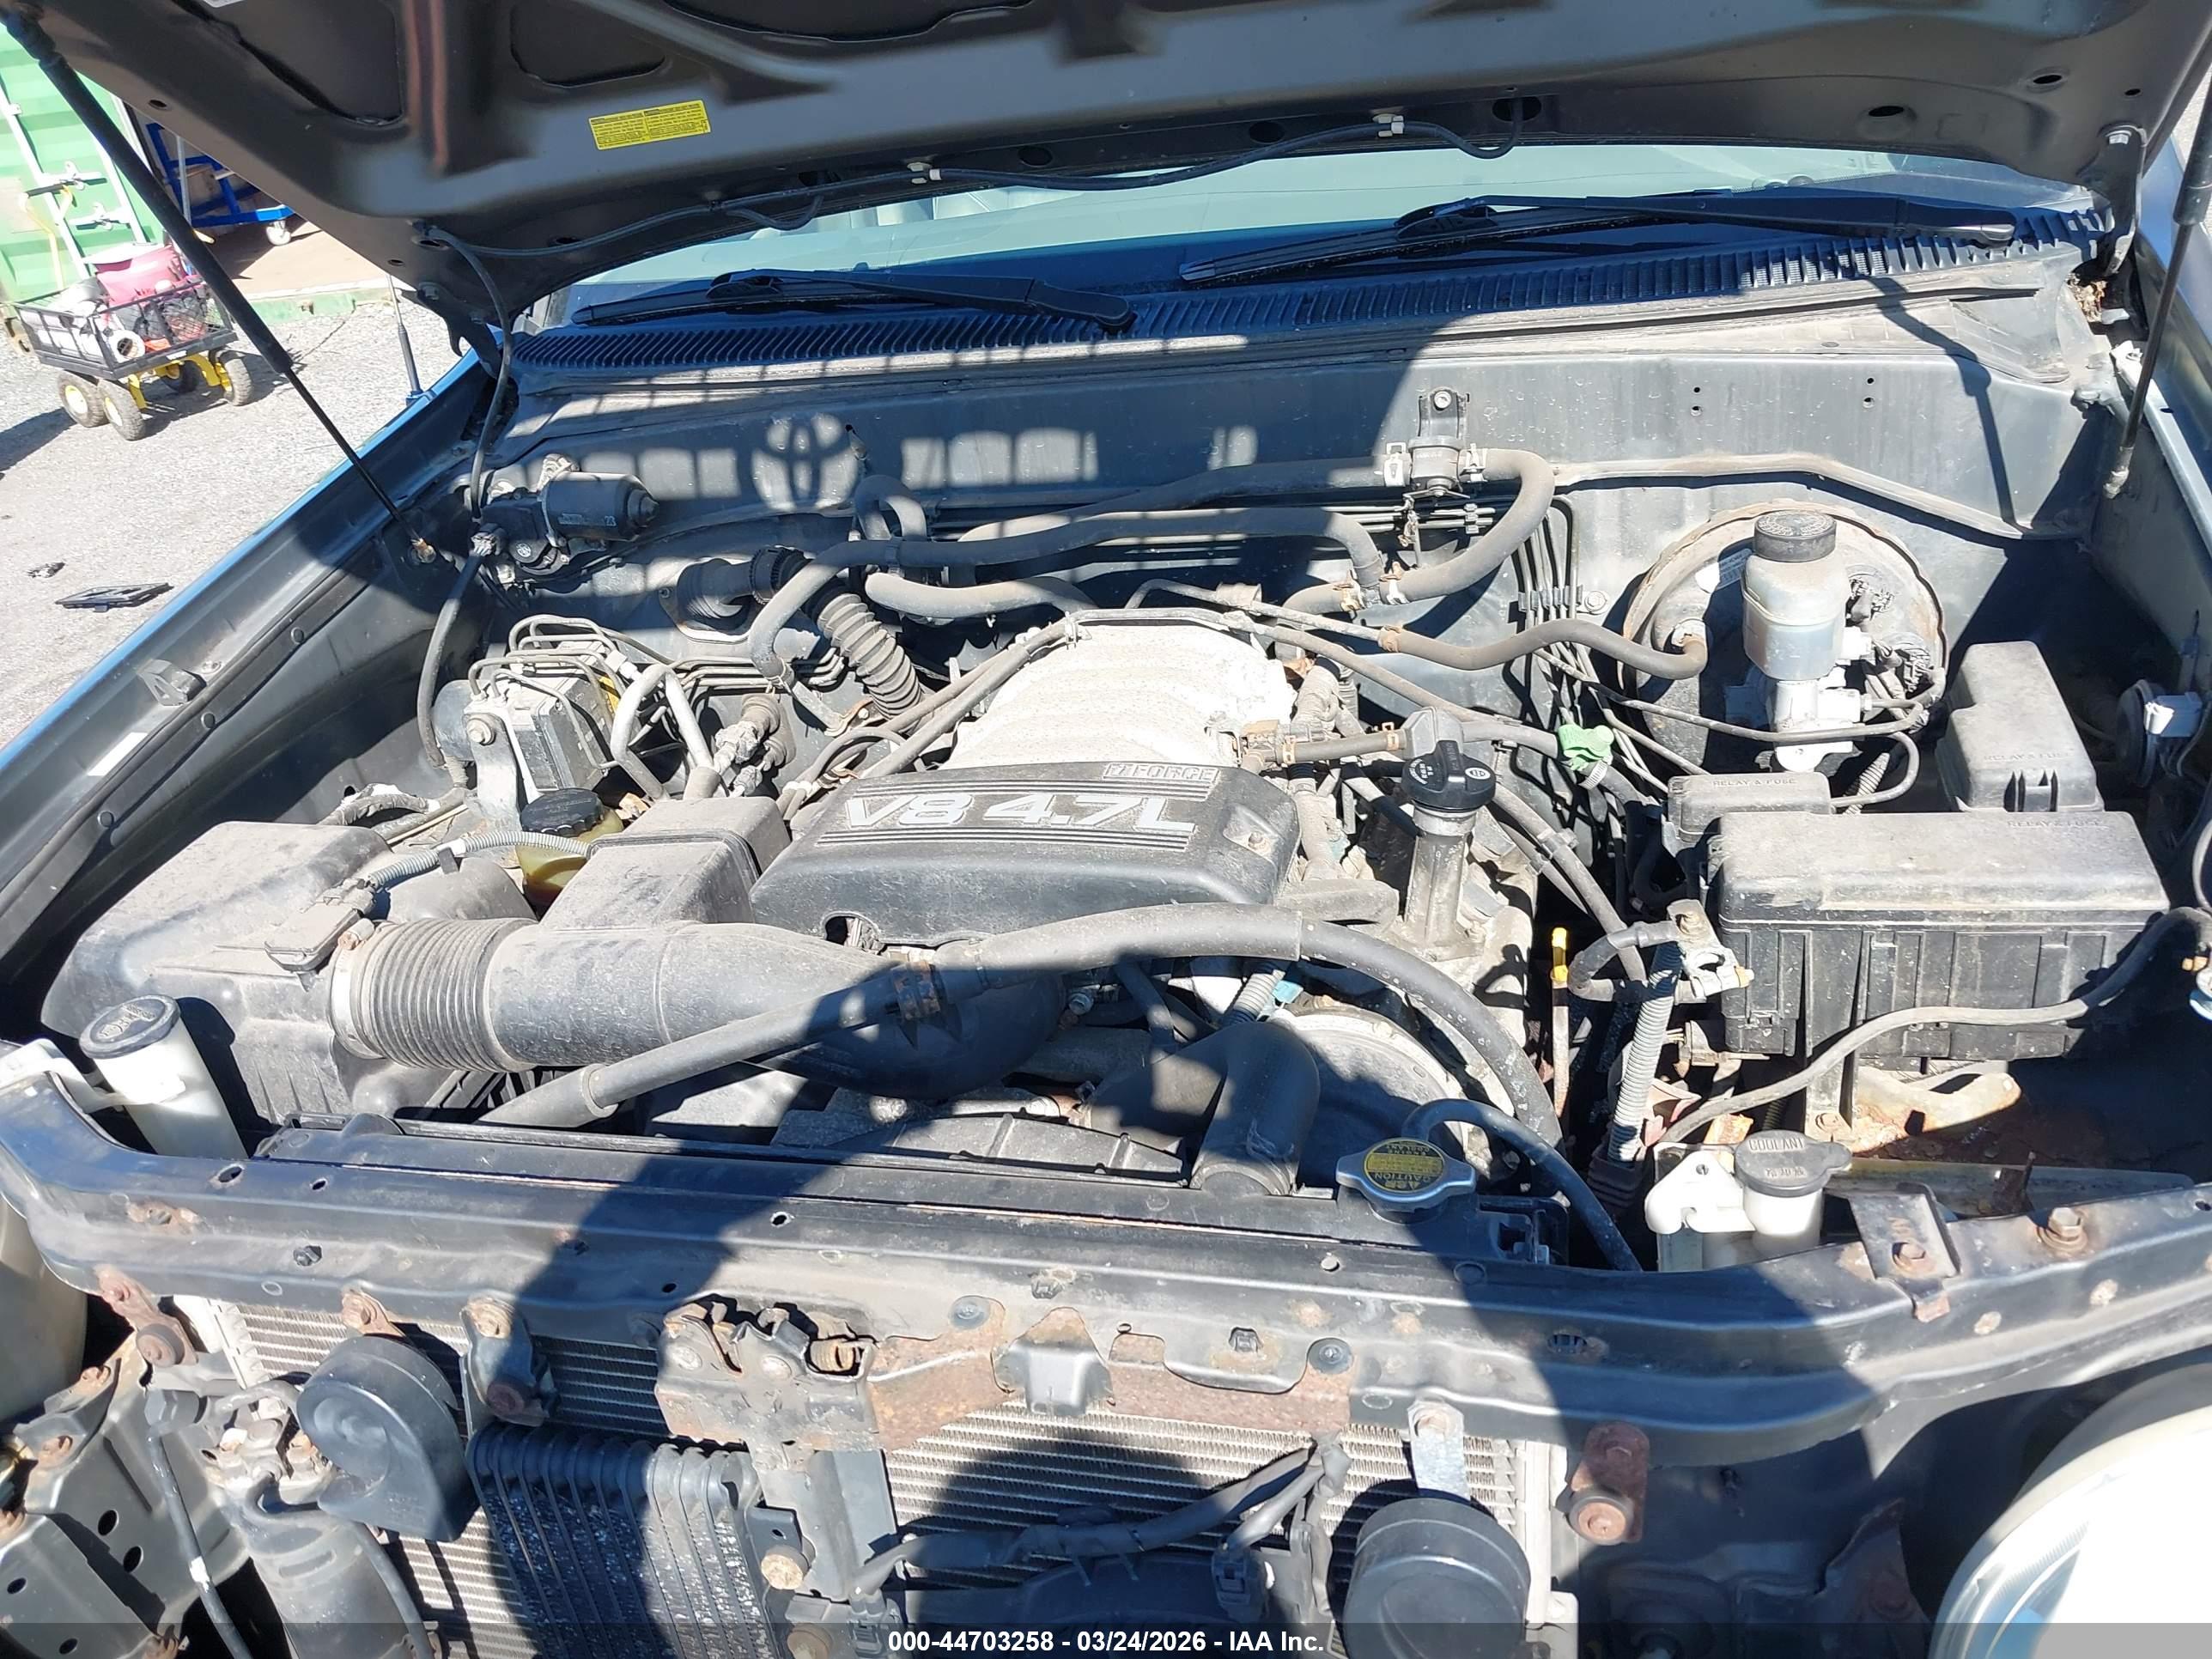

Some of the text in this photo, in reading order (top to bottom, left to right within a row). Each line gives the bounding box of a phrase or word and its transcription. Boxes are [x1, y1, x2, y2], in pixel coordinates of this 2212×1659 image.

[844, 793, 1197, 834] V8 4.7L
[1748, 1138, 1805, 1152] COOLANT
[1375, 1172, 1431, 1182] CAUTION
